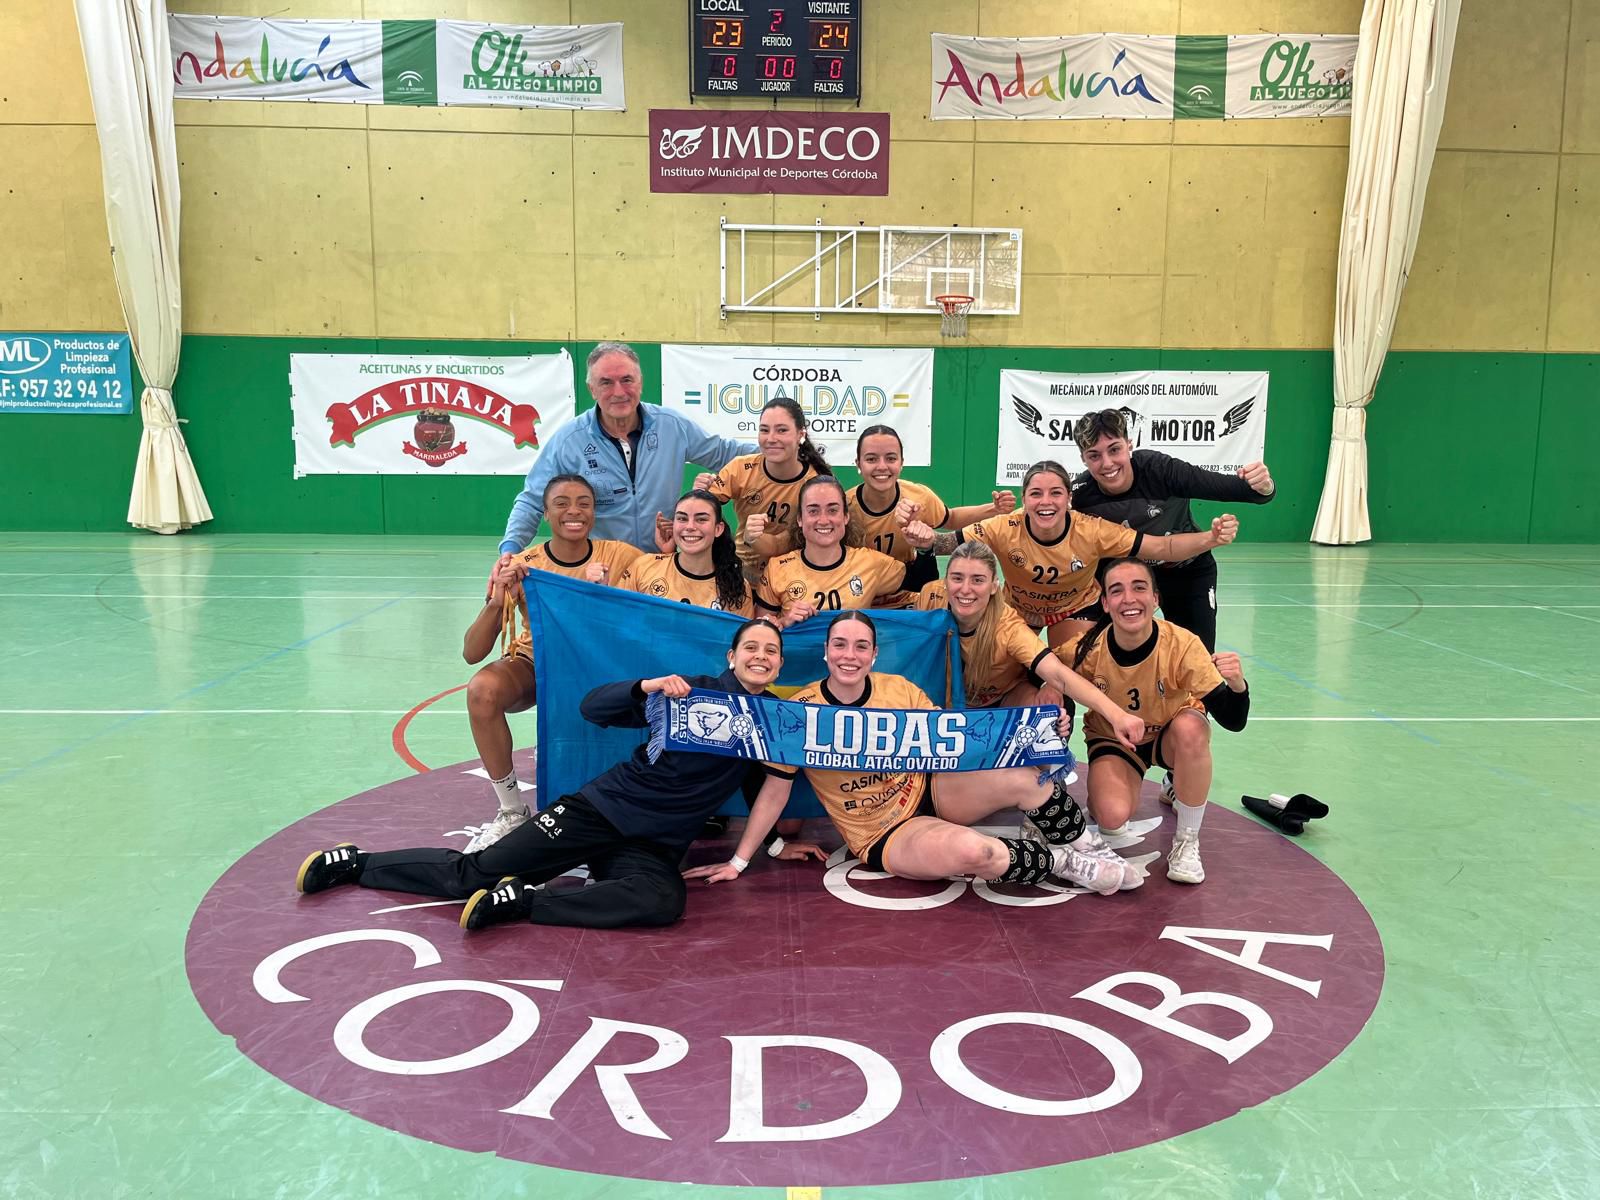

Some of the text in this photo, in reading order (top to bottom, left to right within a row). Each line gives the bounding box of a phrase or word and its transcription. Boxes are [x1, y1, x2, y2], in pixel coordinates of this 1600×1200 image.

[701, 0, 744, 12] LOCAL
[808, 1, 850, 14] VISITANTE
[769, 11, 783, 32] 2
[712, 22, 742, 46] 23
[761, 36, 792, 47] PERIODO
[819, 24, 849, 48] 24
[173, 31, 372, 90] ndalucía
[471, 30, 535, 77] Ok
[1259, 40, 1321, 87] Ok
[723, 57, 736, 78] 0
[829, 59, 842, 80] 0
[936, 48, 1161, 105] Andalucía
[467, 78, 599, 93] AL JUEGO LIMPIO
[708, 80, 738, 91] FALTAS
[760, 82, 791, 93] JUGADOR
[814, 82, 844, 93] FALTAS
[1254, 87, 1273, 100] AL
[1277, 87, 1325, 100] JUEGO
[711, 126, 881, 161] IMDECO
[660, 166, 879, 182] Instituto Municipal de Deportes Córdoba
[54, 339, 120, 350] Productos de
[65, 352, 110, 364] Limpieza
[60, 363, 117, 375] Profesional
[359, 364, 505, 376] ACEITUNAS Y ENCURTIDOS
[753, 364, 842, 382] CÓRDOBA
[19, 379, 48, 398] 957
[53, 379, 73, 398] 32
[77, 380, 98, 399] 94
[102, 380, 122, 399] 12
[1050, 381, 1219, 396] MECÁNICA Y DIAGNOSIS DEL AUTOMÓVIL
[348, 381, 513, 427] LA TINAJA
[737, 420, 756, 432] en
[1048, 419, 1216, 442] SA MOTOR
[413, 449, 458, 461] MARINALEDA
[766, 501, 791, 525] 42
[873, 532, 895, 555] 17
[1031, 565, 1059, 585] 22
[813, 589, 842, 611] 20
[1011, 585, 1078, 601] CASINTRA
[1126, 687, 1140, 711] 3
[679, 698, 688, 739] LOBAS
[803, 705, 967, 758] LOBAS
[806, 751, 959, 770] GLOBAL ATAC OVIEDO
[250, 925, 1336, 1144] CÓRDOBA
